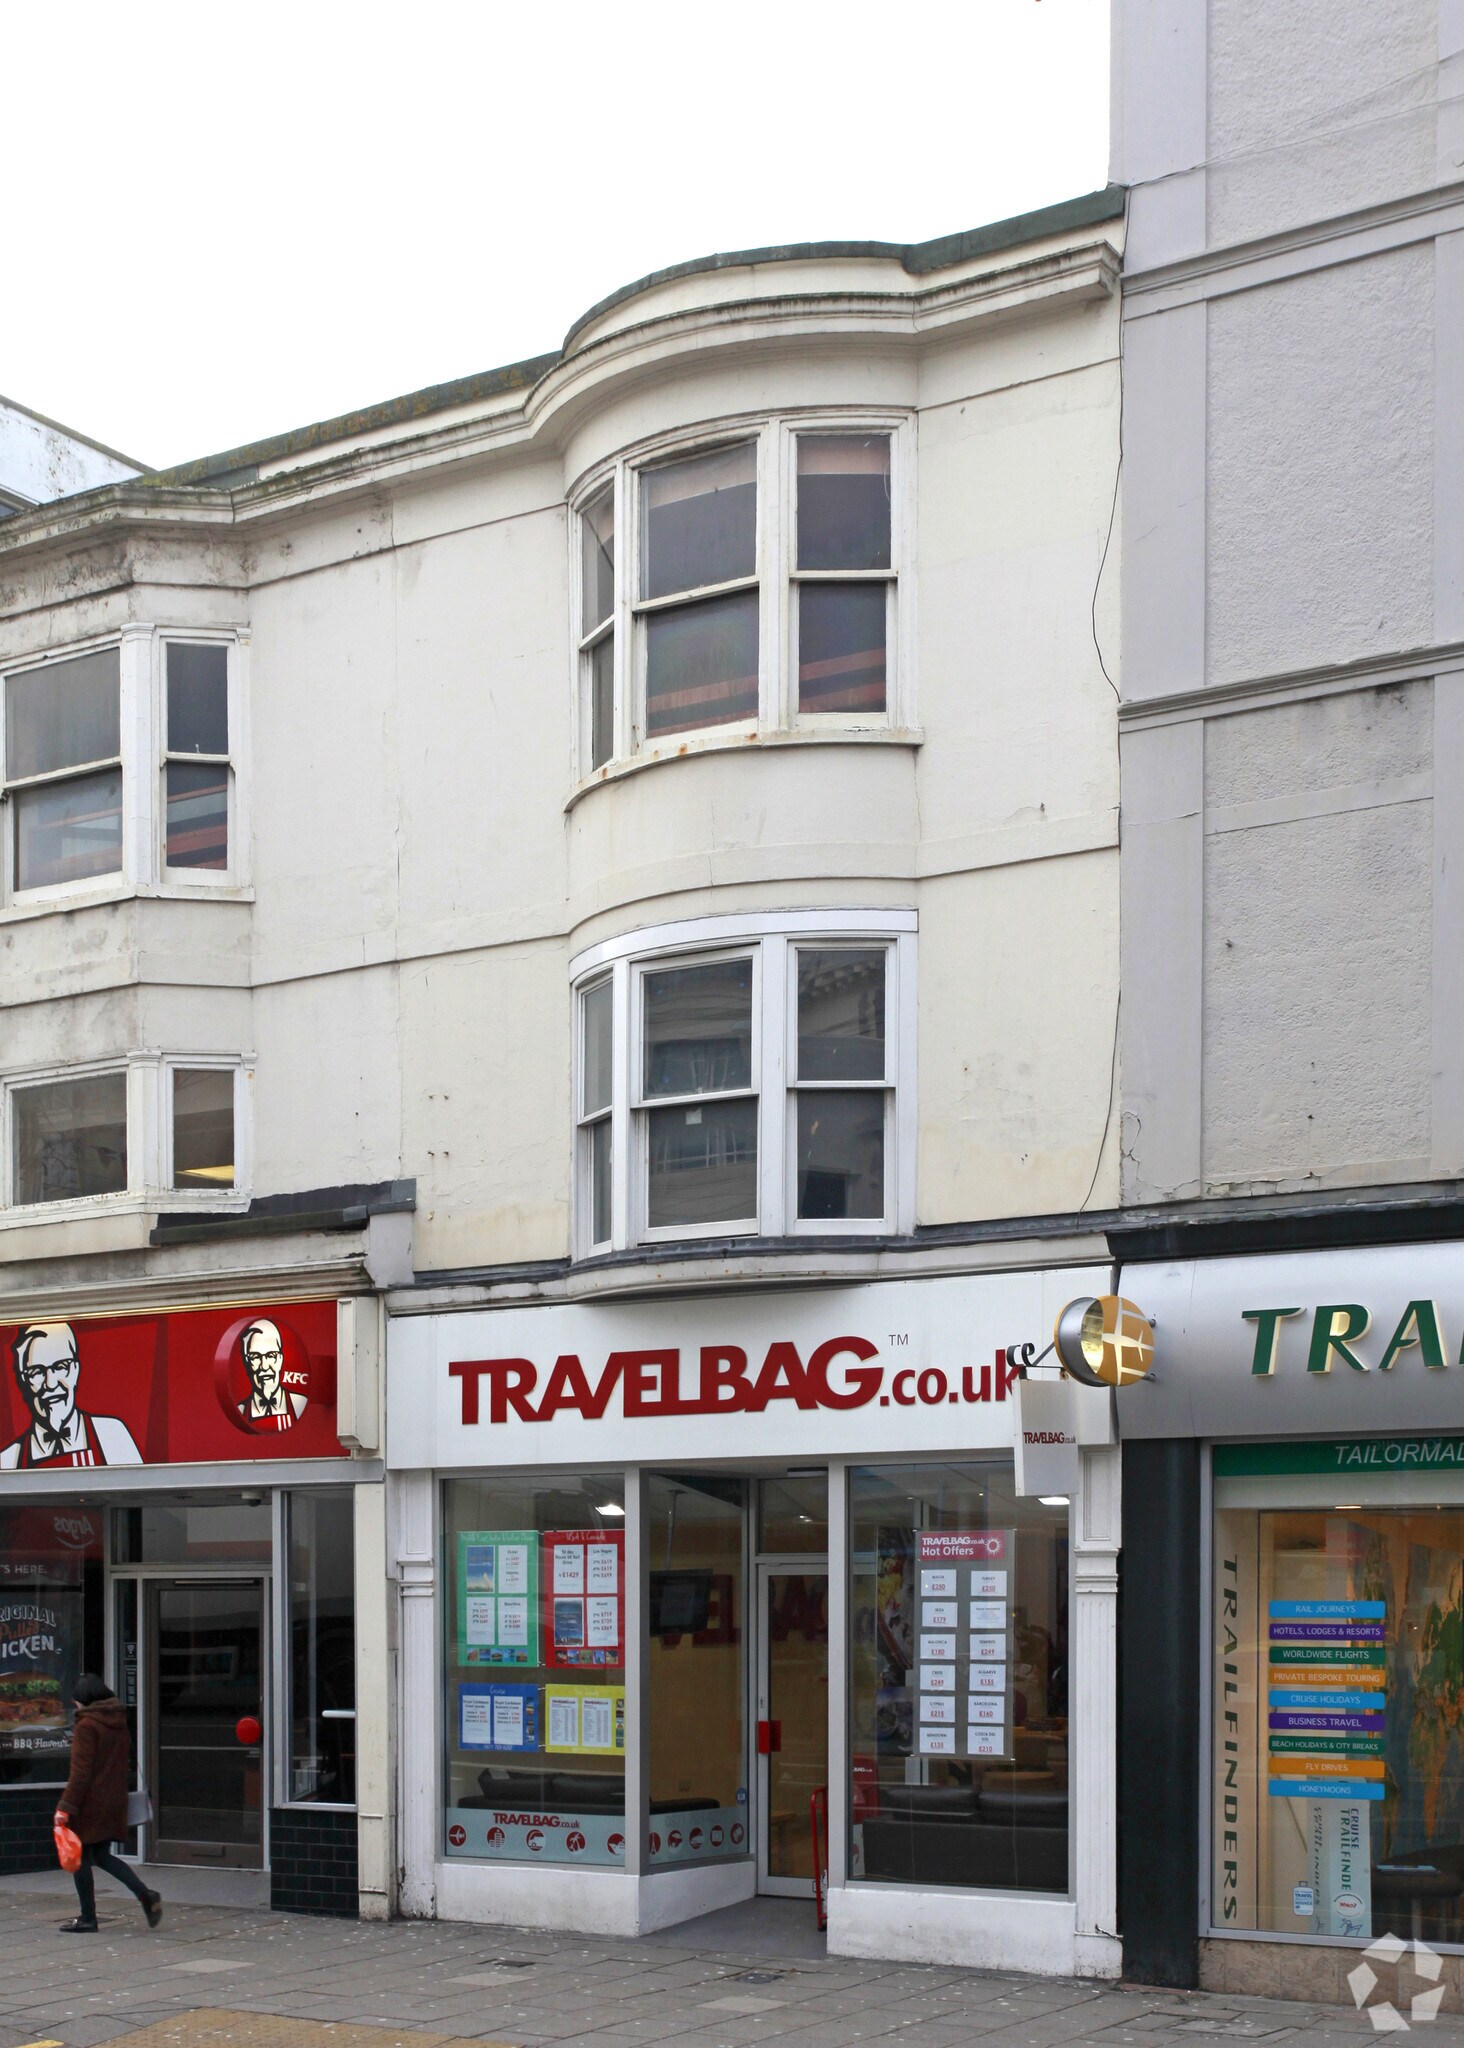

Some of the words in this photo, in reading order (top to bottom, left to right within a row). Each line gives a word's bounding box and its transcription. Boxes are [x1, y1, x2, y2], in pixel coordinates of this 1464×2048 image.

[889, 1334, 909, 1346] TM
[1241, 1300, 1464, 1375] TRA
[282, 1371, 308, 1385] KFC
[1023, 1432, 1076, 1444] TRAVELBAG.co.uk
[922, 1547, 940, 1556] Hot
[943, 1546, 974, 1555] Offers
[0, 1565, 10, 1573] 'S
[1296, 1605, 1312, 1613] RAIL
[1316, 1605, 1356, 1613] JOURNEYS
[1273, 1627, 1304, 1636] HOTELS,
[1307, 1627, 1336, 1635] LODGES
[1346, 1628, 1381, 1636] RESORTS
[1283, 1650, 1333, 1659] WORLDWIDE
[1335, 1650, 1370, 1659] FLIGHTS
[1274, 1673, 1305, 1681] PRIVATE
[1308, 1673, 1343, 1682] BESPOKE
[1346, 1674, 1380, 1682] TOURING
[1290, 1695, 1317, 1703] CRUISE
[1320, 1695, 1360, 1704] HOLIDAYS
[1288, 1717, 1327, 1726] BUSINESS
[1330, 1718, 1362, 1727] TRAVEL
[1223, 1554, 1238, 1920] TRAILFINDERS
[14, 1738, 32, 1749] BBQ
[1295, 1741, 1327, 1749] HOLIDAYS
[1321, 1763, 1348, 1772] DRIVES
[1299, 1785, 1351, 1794] HONEYMOONS
[493, 1813, 580, 1829] TRAVELBAG.co.uk
[1350, 1808, 1360, 1850] CRUISE
[1340, 1809, 1352, 1891] TRAILFINDE
